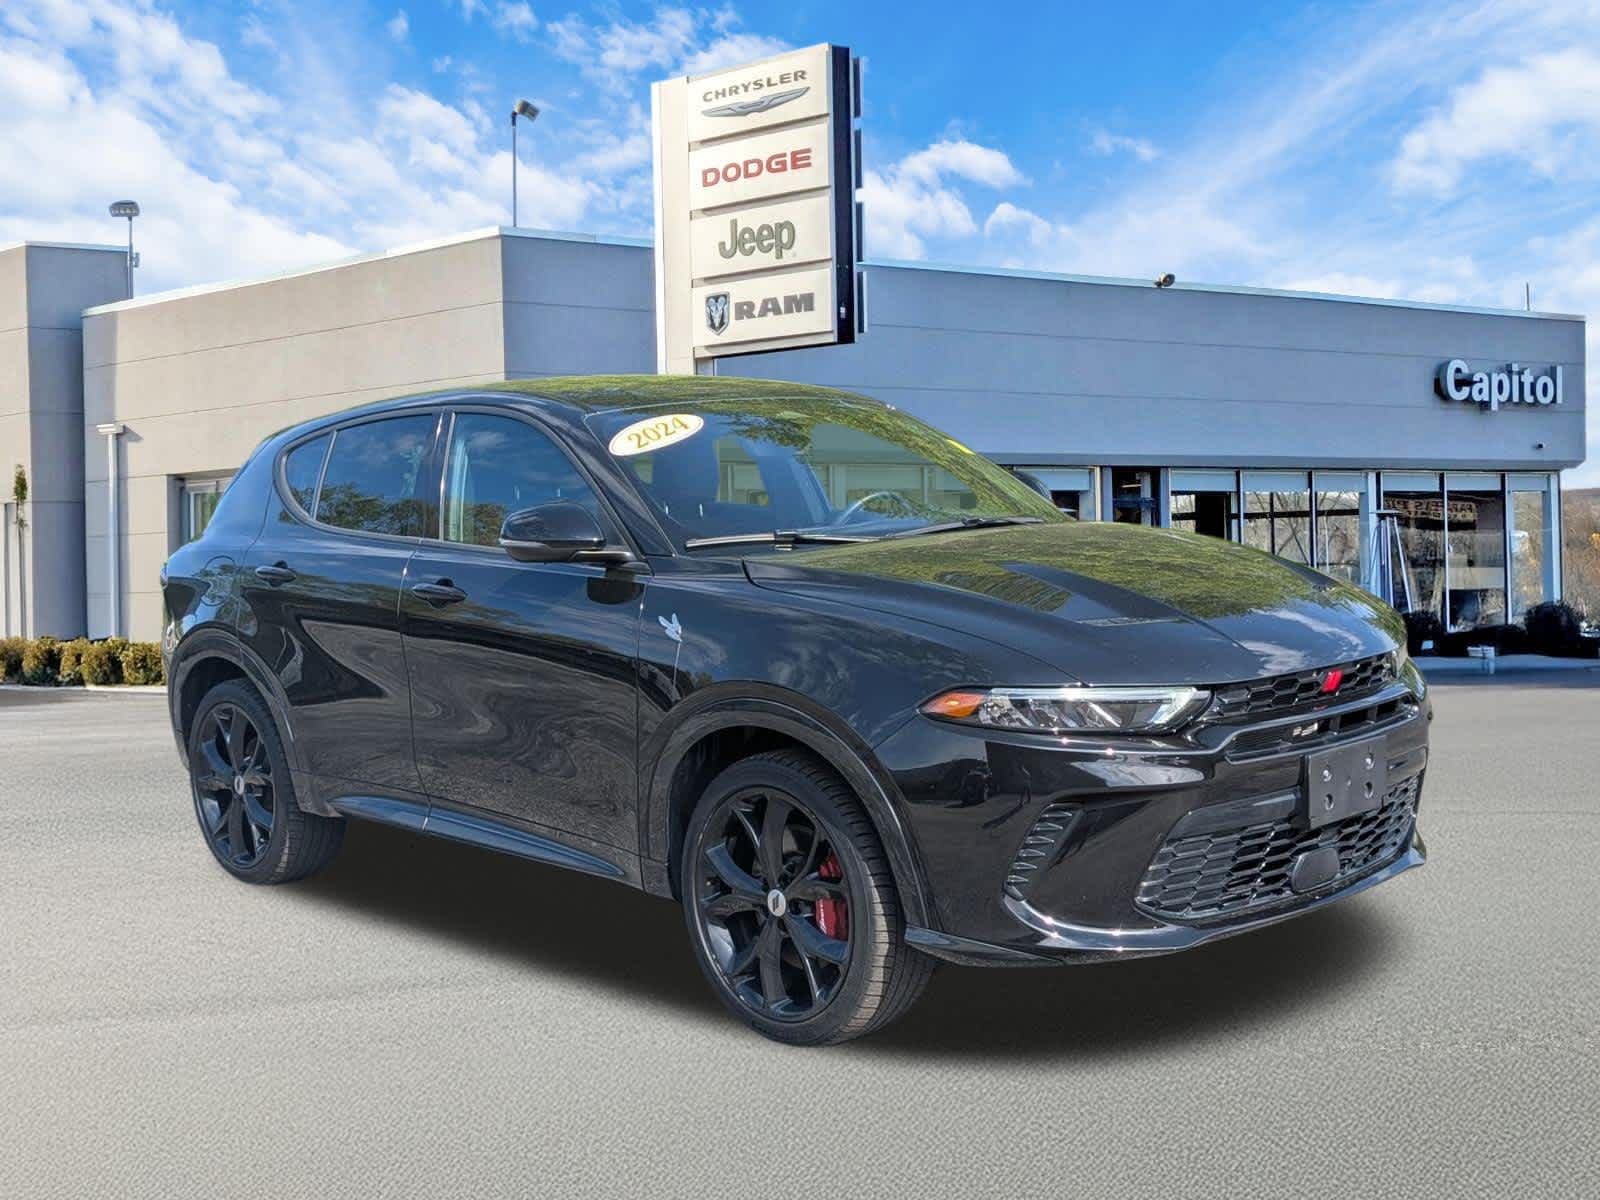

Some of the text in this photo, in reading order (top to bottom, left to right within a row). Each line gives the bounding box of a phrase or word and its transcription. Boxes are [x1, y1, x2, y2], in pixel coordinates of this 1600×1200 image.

[702, 69, 808, 103] CHRYSLER
[702, 147, 812, 188] DODGE
[718, 218, 796, 260] Jeep
[734, 292, 815, 321] RAM
[1445, 358, 1563, 412] Capitol
[627, 416, 690, 449] 2024
